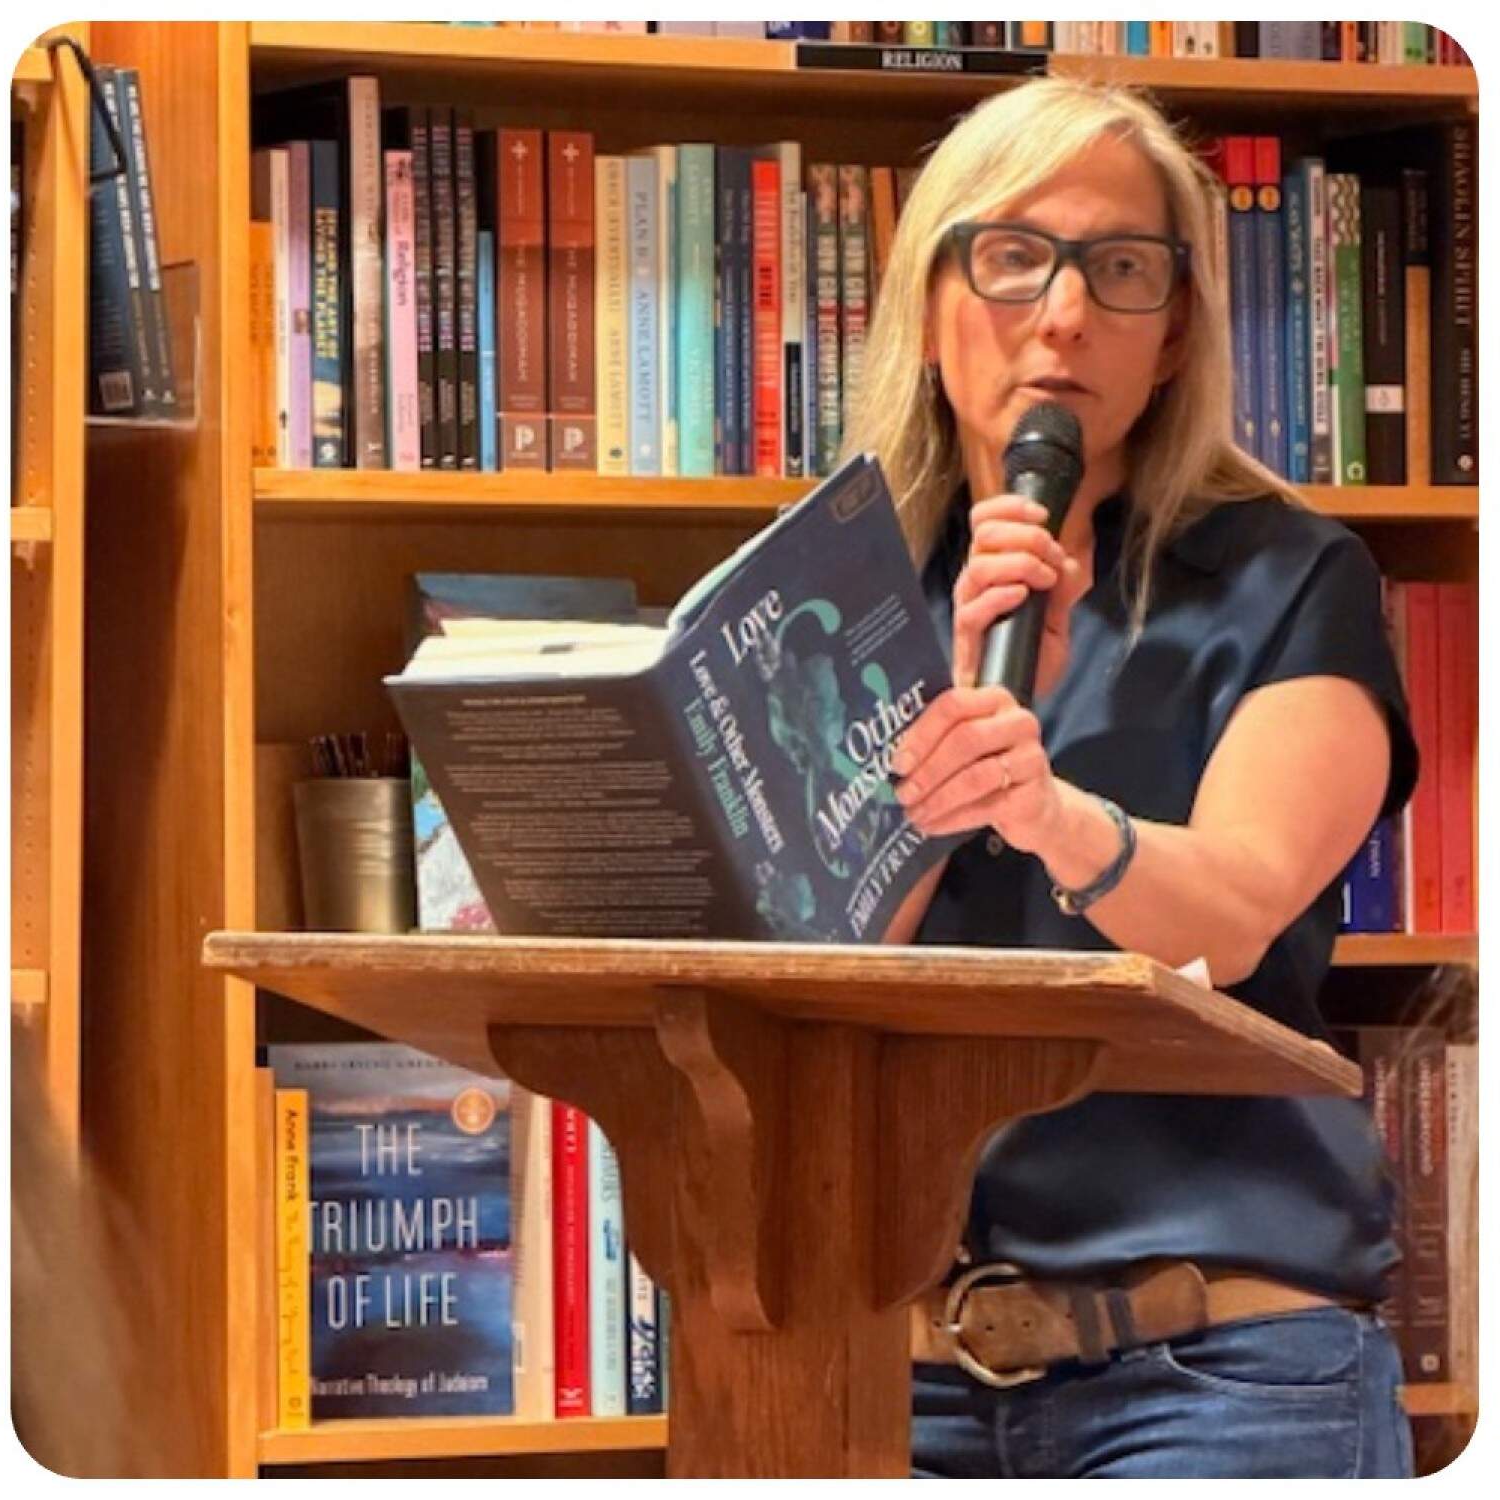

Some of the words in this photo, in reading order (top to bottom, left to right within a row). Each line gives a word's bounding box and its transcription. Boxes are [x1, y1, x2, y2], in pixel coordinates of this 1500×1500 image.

[881, 49, 963, 70] RELIGION
[1451, 127, 1471, 240] SHAOLIN
[634, 192, 650, 238] PLAN
[393, 241, 413, 305] Religion
[817, 236, 838, 272] HOW
[842, 236, 865, 272] HOW
[636, 290, 652, 338] ANNE
[817, 279, 838, 309] GOD
[842, 279, 866, 309] GOD
[1454, 246, 1474, 328] SPIRIT
[818, 314, 839, 385] BECOMES
[636, 341, 652, 423] LAMOTT
[818, 390, 840, 425] REAL
[721, 588, 785, 665] Love
[845, 678, 928, 766] Other
[684, 697, 717, 758] Emily
[708, 757, 749, 839] Franklin
[689, 650, 718, 701] Love
[719, 713, 750, 772] Other
[742, 767, 785, 854] Monsters
[817, 732, 902, 852] Monste
[286, 1109, 299, 1150] Anne
[1419, 1058, 1434, 1174] UNDERGROUND
[356, 1122, 423, 1176] THE
[287, 1156, 299, 1200] Frank
[310, 1197, 478, 1254] TRIUMPH
[326, 1276, 371, 1330] OF
[385, 1271, 460, 1329] LIFE
[366, 1372, 418, 1398] Theology
[420, 1370, 437, 1392] of
[438, 1370, 489, 1393] Judaism
